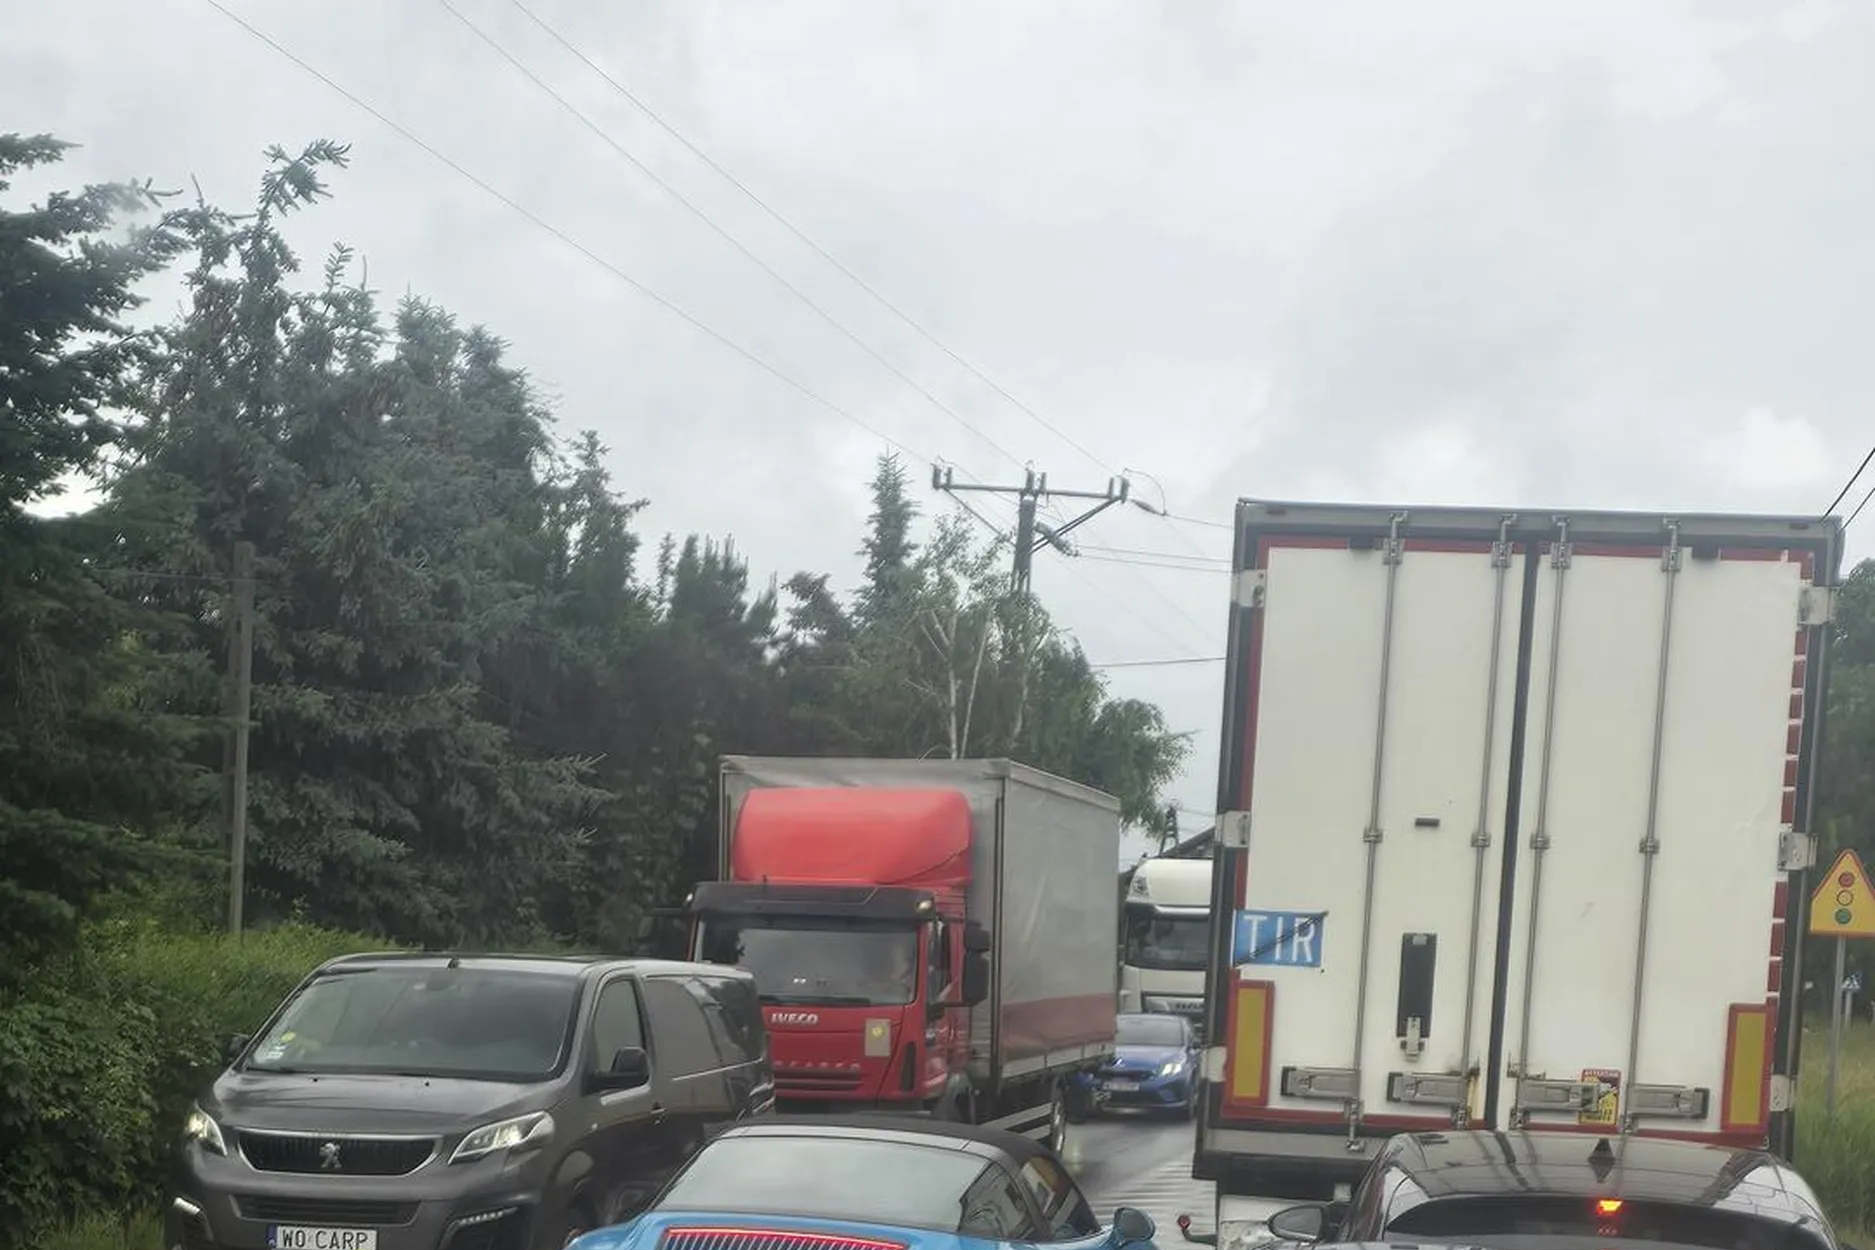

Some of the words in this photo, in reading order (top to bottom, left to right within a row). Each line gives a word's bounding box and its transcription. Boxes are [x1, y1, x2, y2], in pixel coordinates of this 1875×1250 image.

[1243, 914, 1316, 962] TIR
[771, 1012, 819, 1025] IVECO
[282, 1229, 306, 1248] WO
[315, 1230, 368, 1250] CARP
